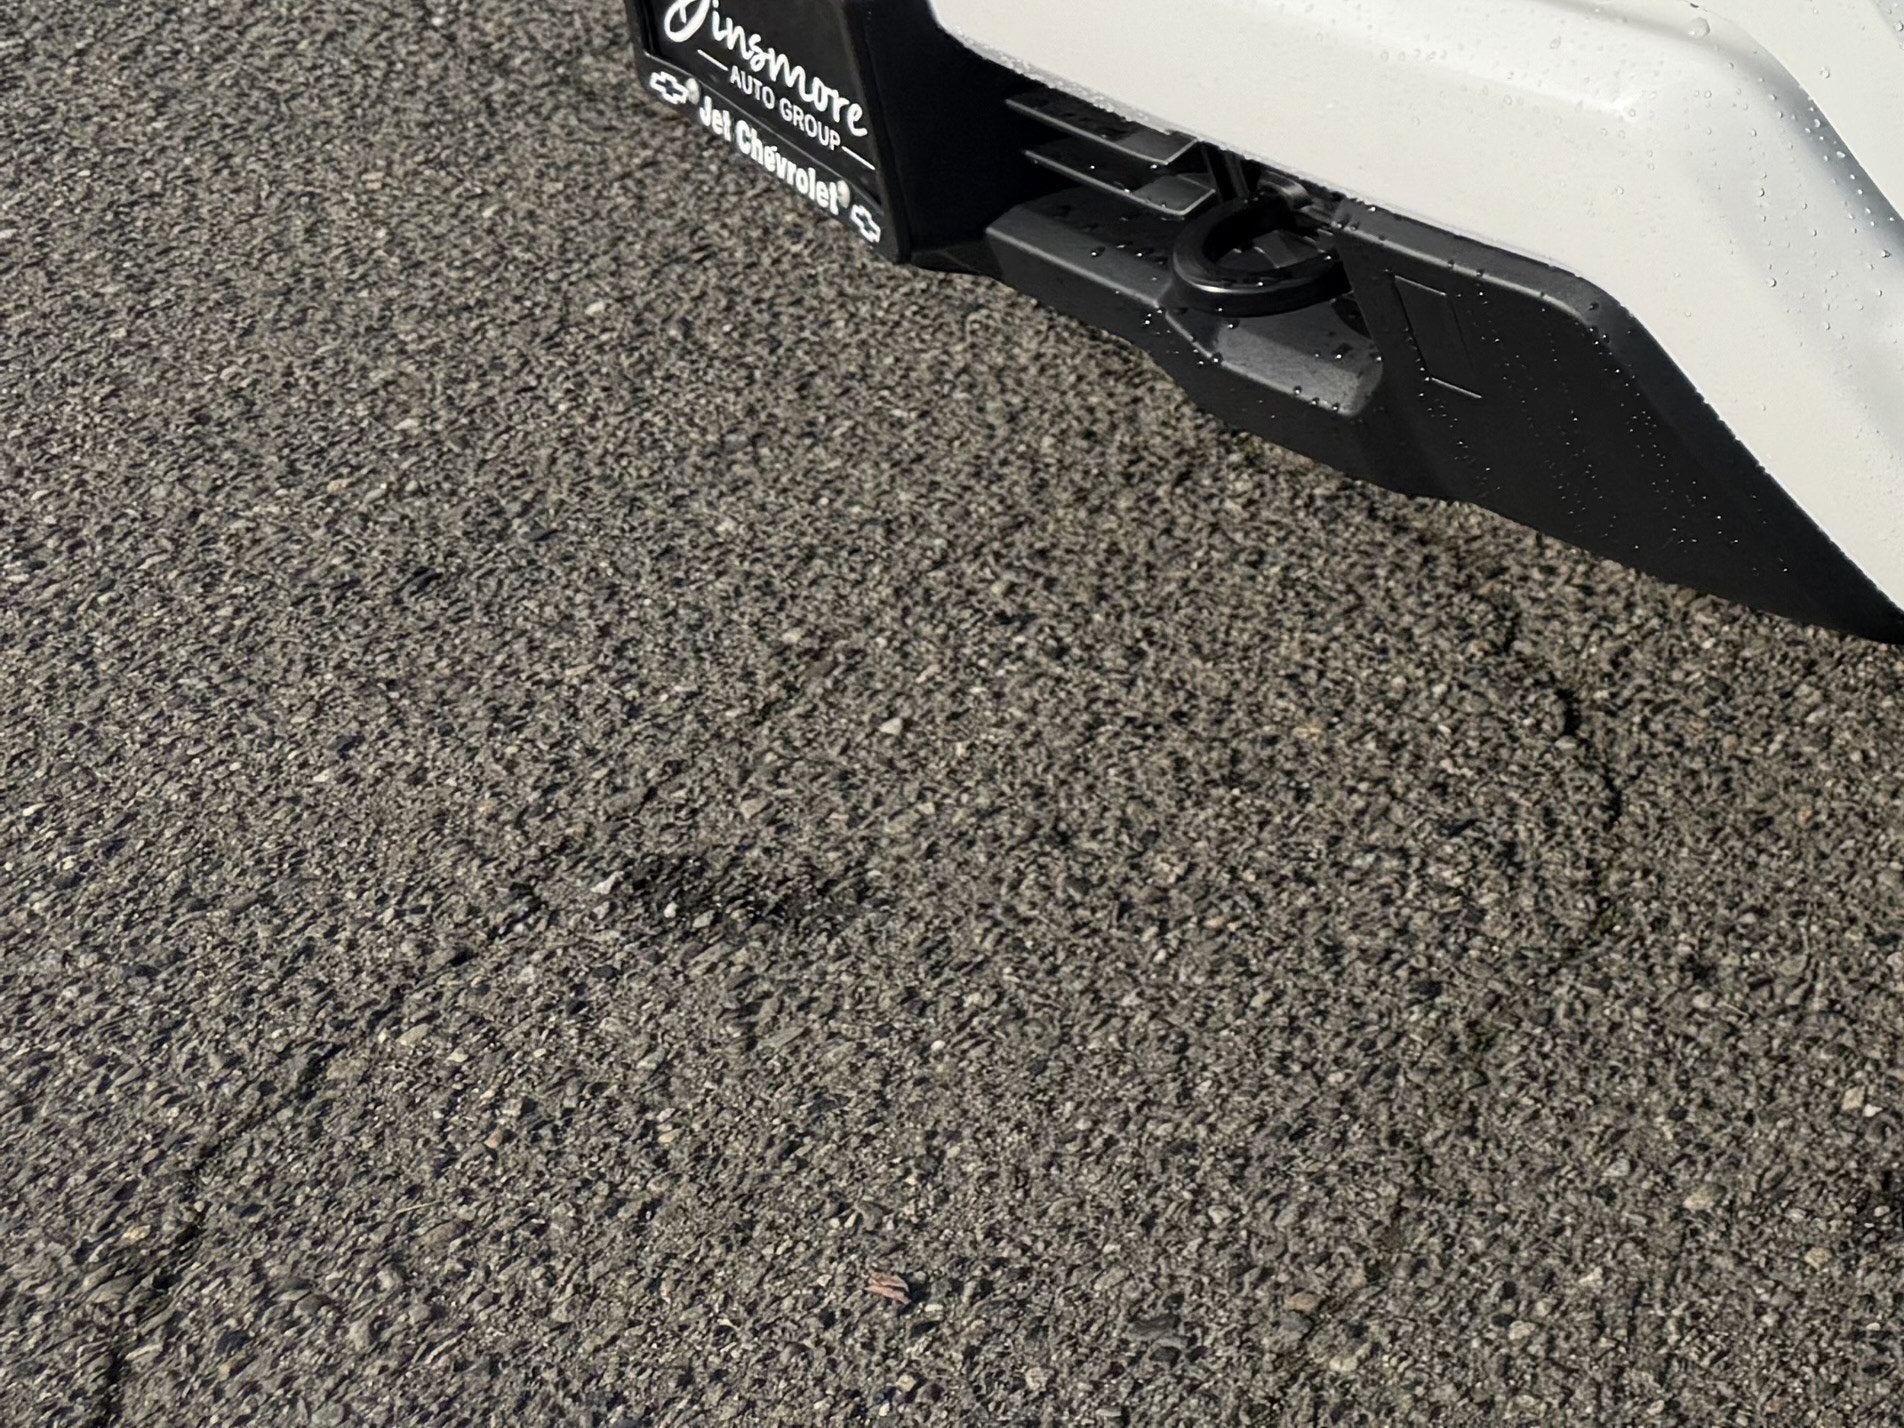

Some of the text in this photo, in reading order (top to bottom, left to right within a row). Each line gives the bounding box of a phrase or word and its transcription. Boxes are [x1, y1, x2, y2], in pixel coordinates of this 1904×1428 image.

[700, 96, 841, 216] Jet Chevrolet
[729, 65, 841, 151] AUTO GROUP
